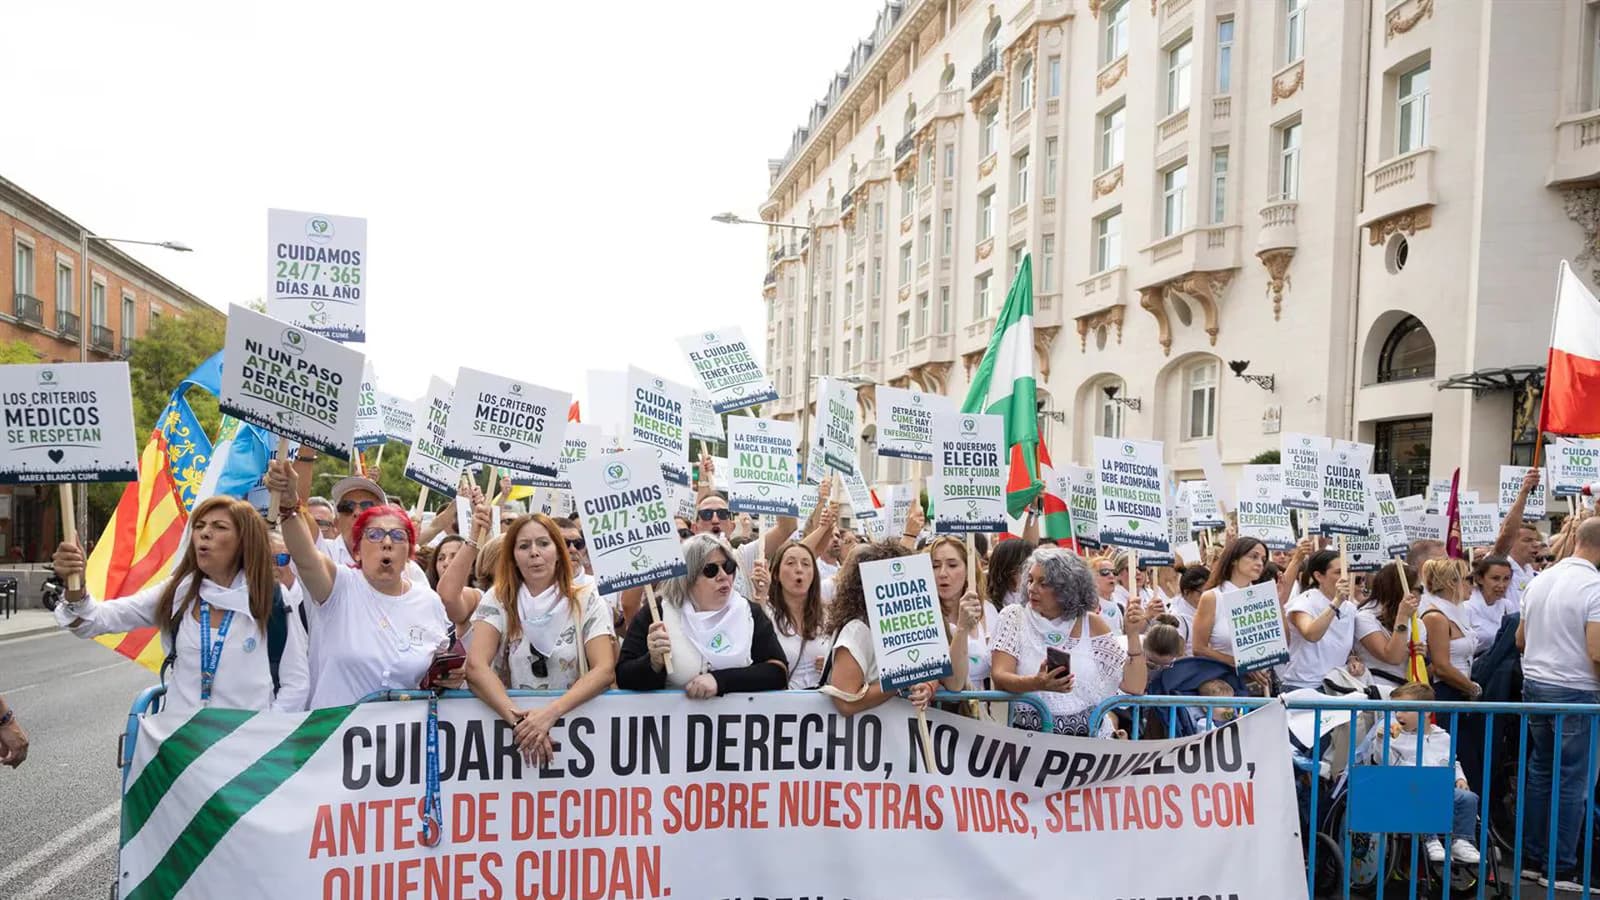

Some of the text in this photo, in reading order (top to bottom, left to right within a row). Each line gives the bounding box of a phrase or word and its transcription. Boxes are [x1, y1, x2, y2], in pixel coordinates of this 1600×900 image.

[277, 243, 361, 266] CUIDAMOS
[276, 280, 360, 299] DÍAS AL AÑO
[690, 342, 746, 361] EL CUIDADO
[695, 350, 753, 371] NO PUEDE
[245, 339, 262, 356] NI
[268, 347, 292, 367] UN
[297, 359, 343, 385] PASO
[701, 360, 758, 382] TENER FECHA
[247, 356, 338, 399] ATRÁS EN
[706, 370, 764, 389] DE CADUCIDAD
[4, 391, 96, 405] LOS CRITERIOS
[242, 366, 338, 412] DERECHOS
[241, 381, 337, 425] ADQUIRIDOS
[479, 392, 547, 417] LOS CRITERIOS
[636, 388, 682, 414] CUIDAR
[5, 404, 99, 427] MÉDICOS
[430, 406, 447, 427] TRA
[475, 403, 544, 433] MÉDICOS
[634, 401, 683, 427] TAMBIÉN
[828, 399, 854, 425] CUIDAR
[892, 406, 927, 418] DETRÁS DE
[892, 414, 930, 427] CUME HAY
[473, 420, 542, 446] SE RESPETAN
[633, 413, 682, 440] MERECE
[833, 416, 850, 434] ES UN
[884, 428, 924, 440] ENFERMEDAD
[899, 424, 930, 435] HISTORIA
[8, 428, 101, 443] SE RESPETAN
[633, 427, 683, 452] PROTECCIÓN
[735, 433, 792, 446] LA ENFERMEDAD
[826, 424, 854, 451] TRABAJO
[734, 442, 794, 457] MARCA EL RITMO.
[944, 441, 997, 452] NO QUEREMOS
[1562, 447, 1599, 456] CUIDAR
[740, 454, 788, 471] NO LA
[944, 452, 998, 467] ELEGIR
[1102, 459, 1158, 479] LA PROTECCIÓN
[1294, 455, 1319, 466] CUM
[1570, 456, 1592, 467] NO
[733, 466, 795, 484] BUROCRACIA
[944, 468, 1001, 478] ENTRE CUIDAR
[1101, 472, 1160, 491] DEBE ACOMPAÑAR
[1326, 465, 1361, 480] CUIDAR
[944, 484, 1002, 498] SOBREVIVIR
[1085, 486, 1097, 497] APO
[1286, 478, 1319, 489] SEGURID
[1324, 475, 1364, 490] TAMBIÉN
[584, 485, 662, 515] CUIDAMOS
[1071, 494, 1097, 511] MENO
[1102, 485, 1161, 505] MIENTRAS EXISTA
[1323, 487, 1365, 504] MERECE
[1104, 499, 1161, 518] LA NECESIDAD
[1240, 501, 1289, 515] NO SOMOS
[1323, 499, 1365, 513] PROTECCIÓN
[1379, 500, 1396, 516] NO
[1240, 515, 1290, 527] EXPEDIENTES
[593, 521, 671, 550] DÍAS AL AÑO
[1337, 533, 1381, 543] CESITAMOS
[1337, 540, 1380, 552] SGURIDAD
[875, 578, 928, 600] CUIDAR
[876, 594, 933, 617] TAMBIÉN
[1231, 598, 1275, 617] NO PONGÁIS
[879, 611, 935, 635] MERECE
[1231, 607, 1278, 628] TRABAS
[1257, 623, 1265, 631] YA
[1264, 619, 1279, 629] TIENE
[882, 626, 939, 649] PROTECCIÓN
[1236, 627, 1281, 647] BASTANTE
[343, 719, 523, 791] CUIDAR
[539, 716, 596, 779] ES
[610, 714, 672, 777] UN
[686, 712, 894, 780] DERECHO,
[908, 717, 960, 776] NO
[967, 734, 1032, 783] UN
[308, 780, 1256, 860] ANTES DE DECIDIR SOBRE NUESTRAS VIDAS, SENTAOS CON
[322, 845, 672, 900] QUIENES CUIDAN.
